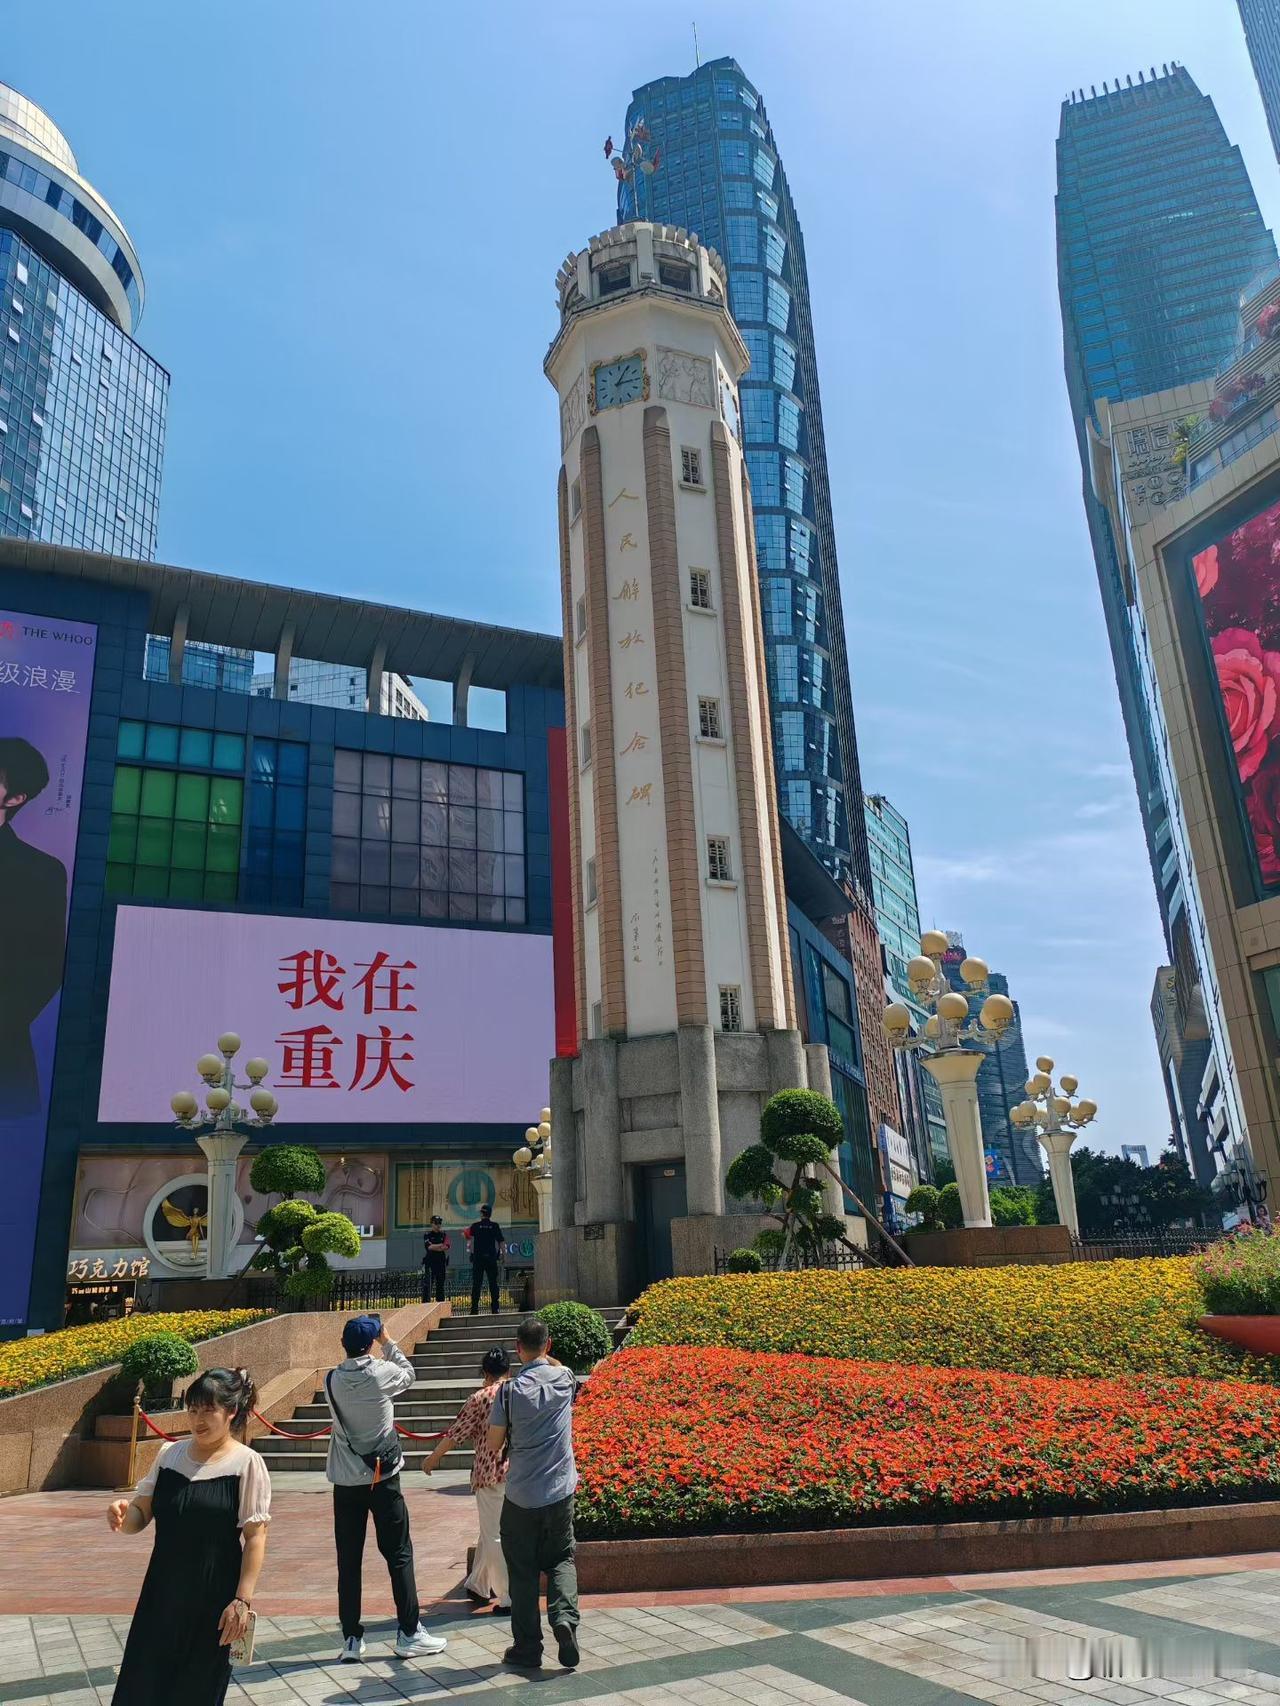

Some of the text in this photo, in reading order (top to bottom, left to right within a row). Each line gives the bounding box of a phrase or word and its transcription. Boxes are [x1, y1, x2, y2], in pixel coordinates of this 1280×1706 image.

[23, 626, 93, 646] THE WHOO
[0, 661, 80, 693] 级浪漫
[277, 949, 418, 1015] 我在
[272, 1024, 417, 1093] 重庆
[68, 1257, 150, 1279] 巧克力馆
